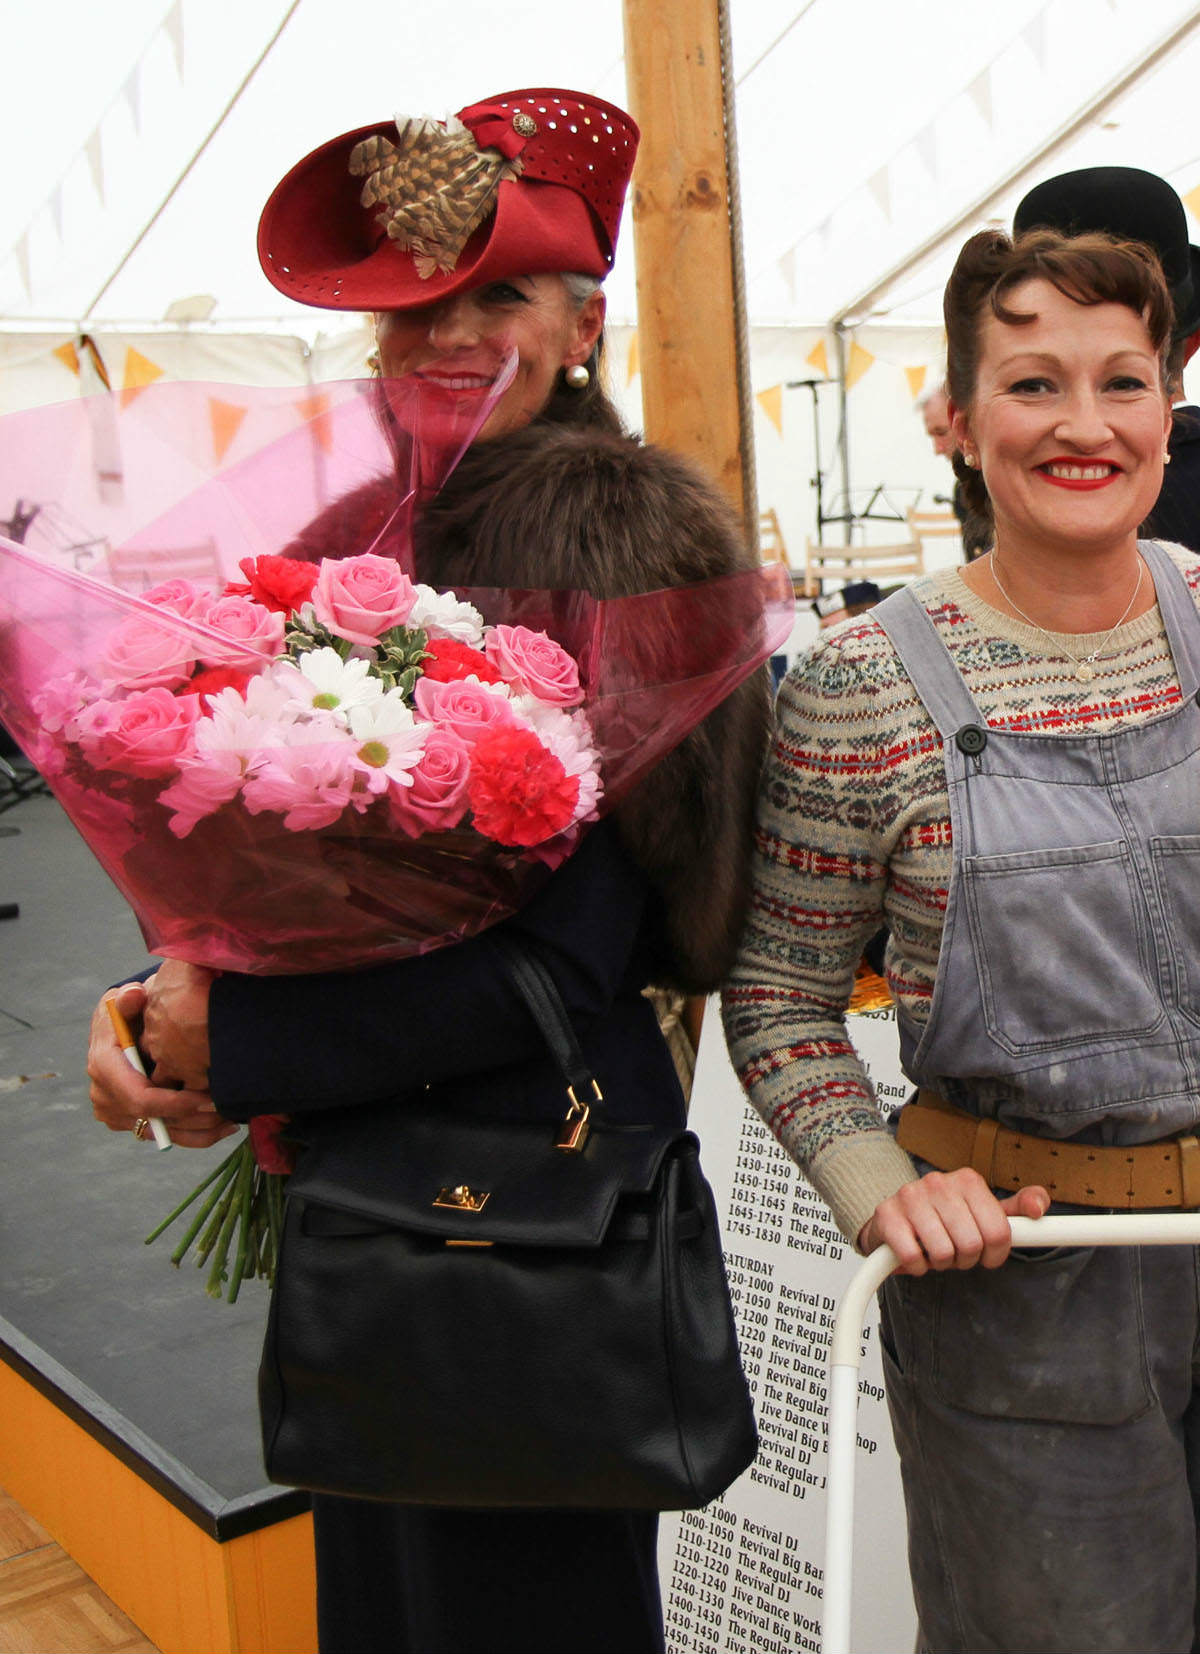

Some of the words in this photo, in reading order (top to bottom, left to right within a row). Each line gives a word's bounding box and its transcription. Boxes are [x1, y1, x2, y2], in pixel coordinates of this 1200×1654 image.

[876, 1082, 906, 1098] Band
[734, 1172, 788, 1194] 1450-1540
[736, 1155, 791, 1178] 1430-1450
[731, 1188, 785, 1211] 1615-1645
[792, 1202, 832, 1223] Revival
[726, 1220, 780, 1244] 1745-1830
[787, 1235, 827, 1257] Revival
[830, 1246, 843, 1260] DJ
[728, 1204, 783, 1227] 1645-1745
[790, 1219, 808, 1235] The
[811, 1224, 849, 1245] Regula
[721, 1251, 774, 1276] SATURDAY
[726, 1269, 774, 1293] 930-1000
[780, 1285, 819, 1307] Revival
[822, 1297, 836, 1311] DJ
[729, 1287, 771, 1310] 00-1050
[777, 1301, 816, 1324] Revival
[732, 1305, 768, 1327] 0-1200
[775, 1317, 793, 1335] The
[797, 1324, 833, 1346] Regula
[736, 1325, 766, 1343] -1220
[772, 1334, 811, 1357] Revival
[814, 1348, 827, 1362] DJ
[767, 1368, 806, 1391] Revival
[809, 1381, 827, 1401] Big
[768, 1352, 790, 1369] Jive
[793, 1359, 827, 1380] Dance
[857, 1380, 885, 1401] shop
[760, 1401, 782, 1418] Jive
[785, 1409, 818, 1431] Dance
[764, 1384, 782, 1401] The
[786, 1391, 829, 1417] Regular
[757, 1434, 795, 1459] Revival
[798, 1450, 811, 1465] DJ
[758, 1418, 798, 1442] Revival
[801, 1433, 819, 1453] Big
[750, 1468, 790, 1493] Revival
[793, 1484, 806, 1499] DJ
[775, 1460, 818, 1486] Regular
[680, 1510, 734, 1542] 1000-1050
[740, 1535, 779, 1562] Revival
[783, 1552, 801, 1574] Big
[804, 1561, 824, 1580] Ban
[701, 1506, 737, 1526] 0-1000
[743, 1518, 782, 1544] Revival
[785, 1535, 798, 1551] DJ
[675, 1543, 729, 1575] 1210-1220
[735, 1569, 774, 1596] Revival
[777, 1587, 791, 1603] DJ
[678, 1527, 732, 1559] 1110-1210
[738, 1551, 756, 1570] The
[760, 1561, 803, 1589] Regular
[669, 1592, 722, 1626] 1400-1430
[728, 1619, 747, 1638] The
[671, 1576, 724, 1609] 1240-1330
[730, 1602, 769, 1631] Revival
[773, 1621, 791, 1643] Big
[672, 1560, 727, 1593] 1220-1240
[732, 1586, 753, 1605] Jive
[756, 1596, 790, 1621] Dance
[793, 1611, 822, 1636] Work
[666, 1609, 720, 1643] 1430-1450
[725, 1637, 746, 1654] Jive
